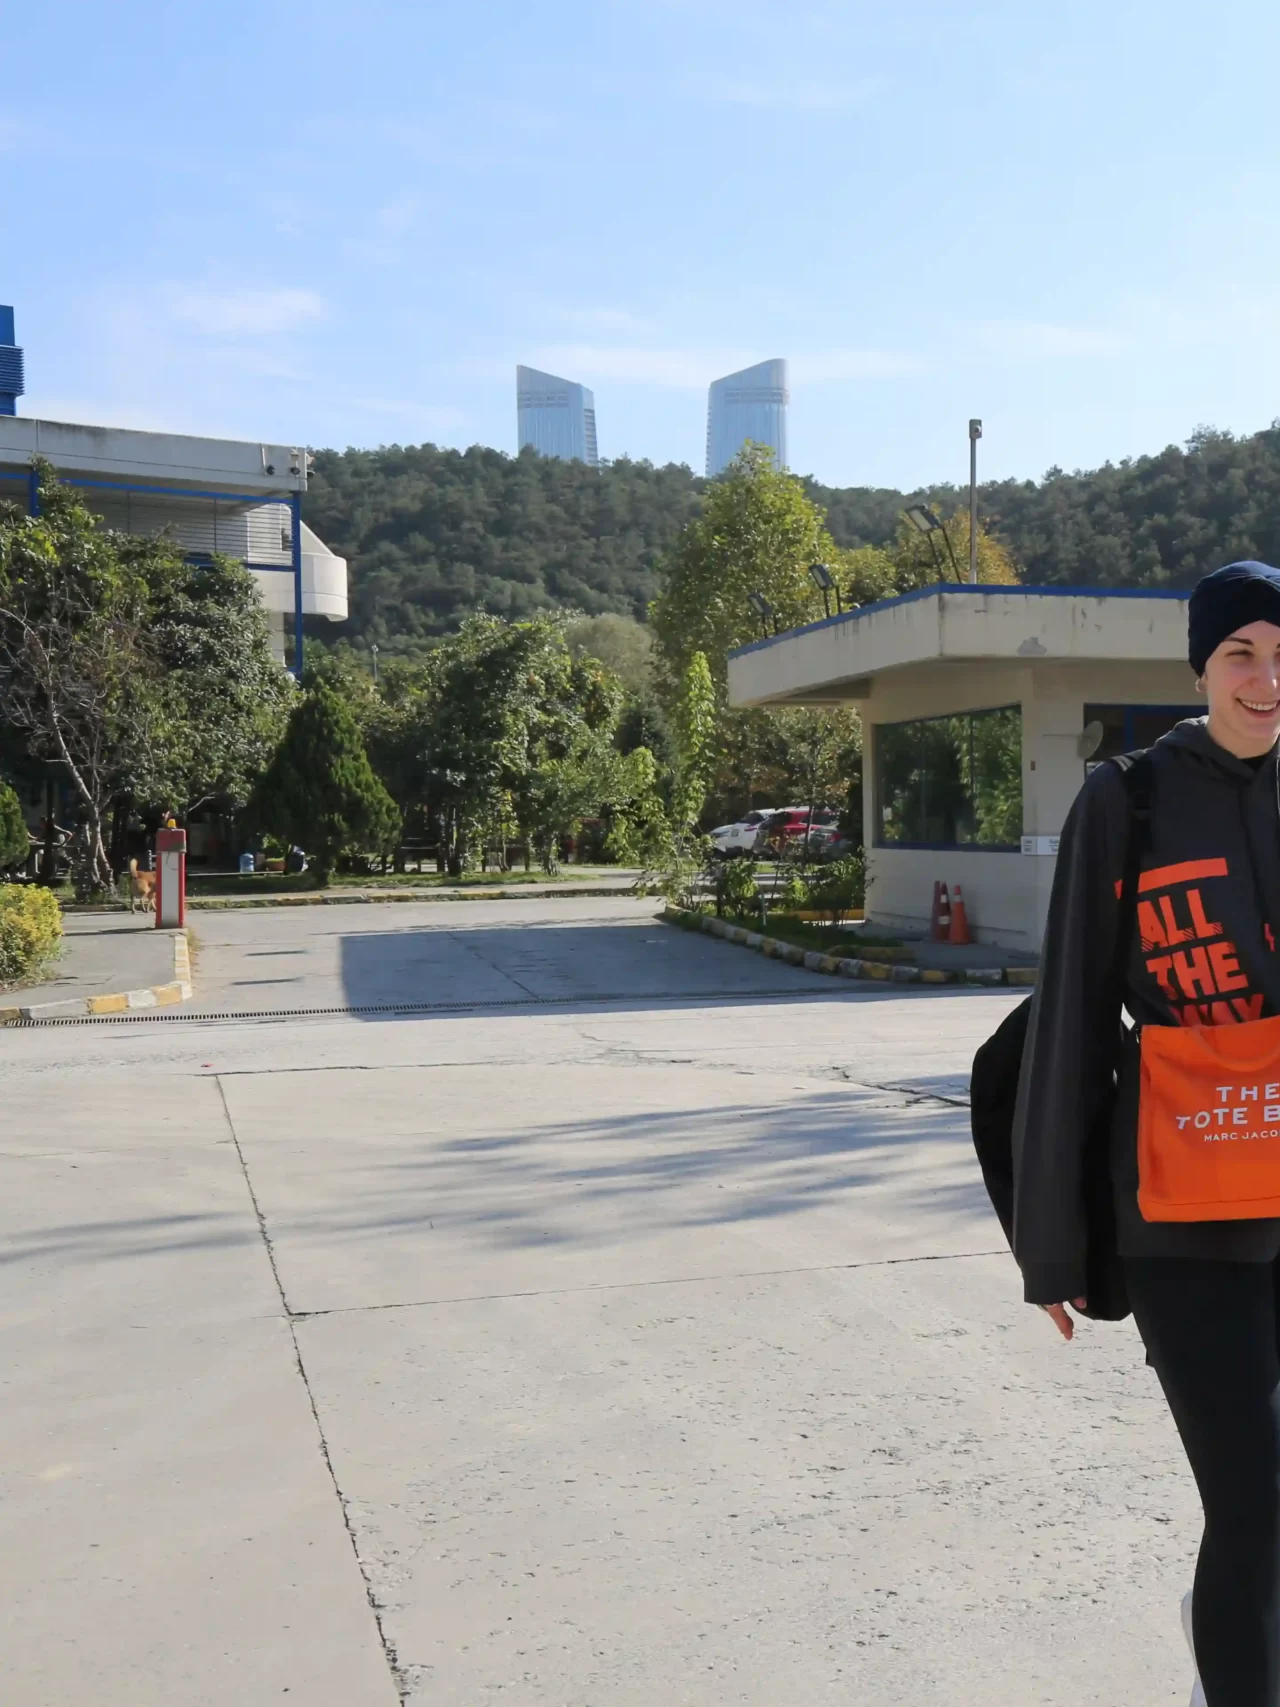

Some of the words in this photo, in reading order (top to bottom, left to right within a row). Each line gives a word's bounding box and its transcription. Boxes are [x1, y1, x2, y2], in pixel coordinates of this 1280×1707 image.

[1137, 889, 1223, 953] ALL
[1145, 941, 1249, 1000] THE
[1216, 1083, 1280, 1102] THE
[1176, 1107, 1249, 1130] TOTE
[1204, 1132, 1238, 1142] MARC
